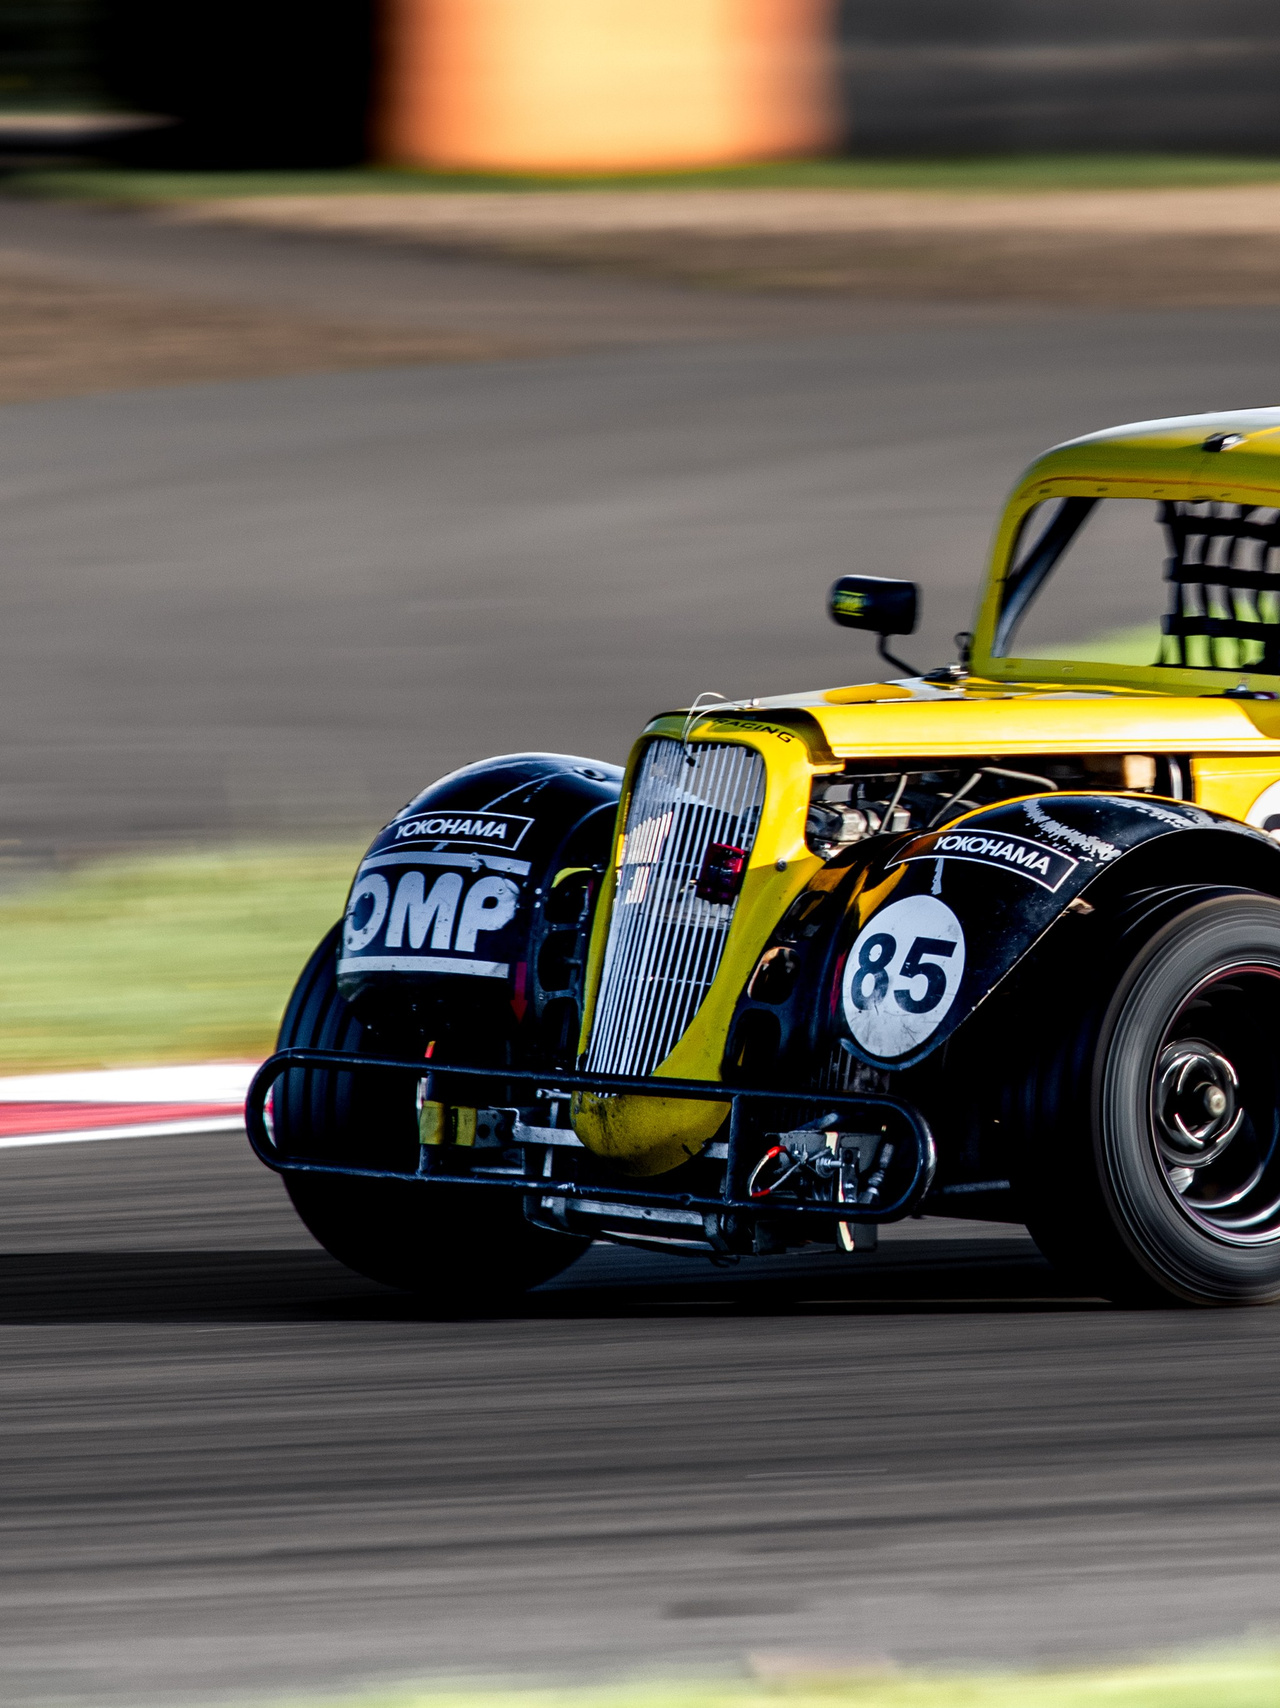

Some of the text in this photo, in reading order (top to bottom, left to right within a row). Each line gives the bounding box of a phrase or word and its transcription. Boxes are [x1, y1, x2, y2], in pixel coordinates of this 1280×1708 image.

[711, 717, 795, 743] RACING
[395, 818, 508, 840] YOKOHAMA
[933, 835, 1051, 876] YOKOHAMA
[343, 871, 520, 953] OMP
[851, 932, 957, 1014] 85
